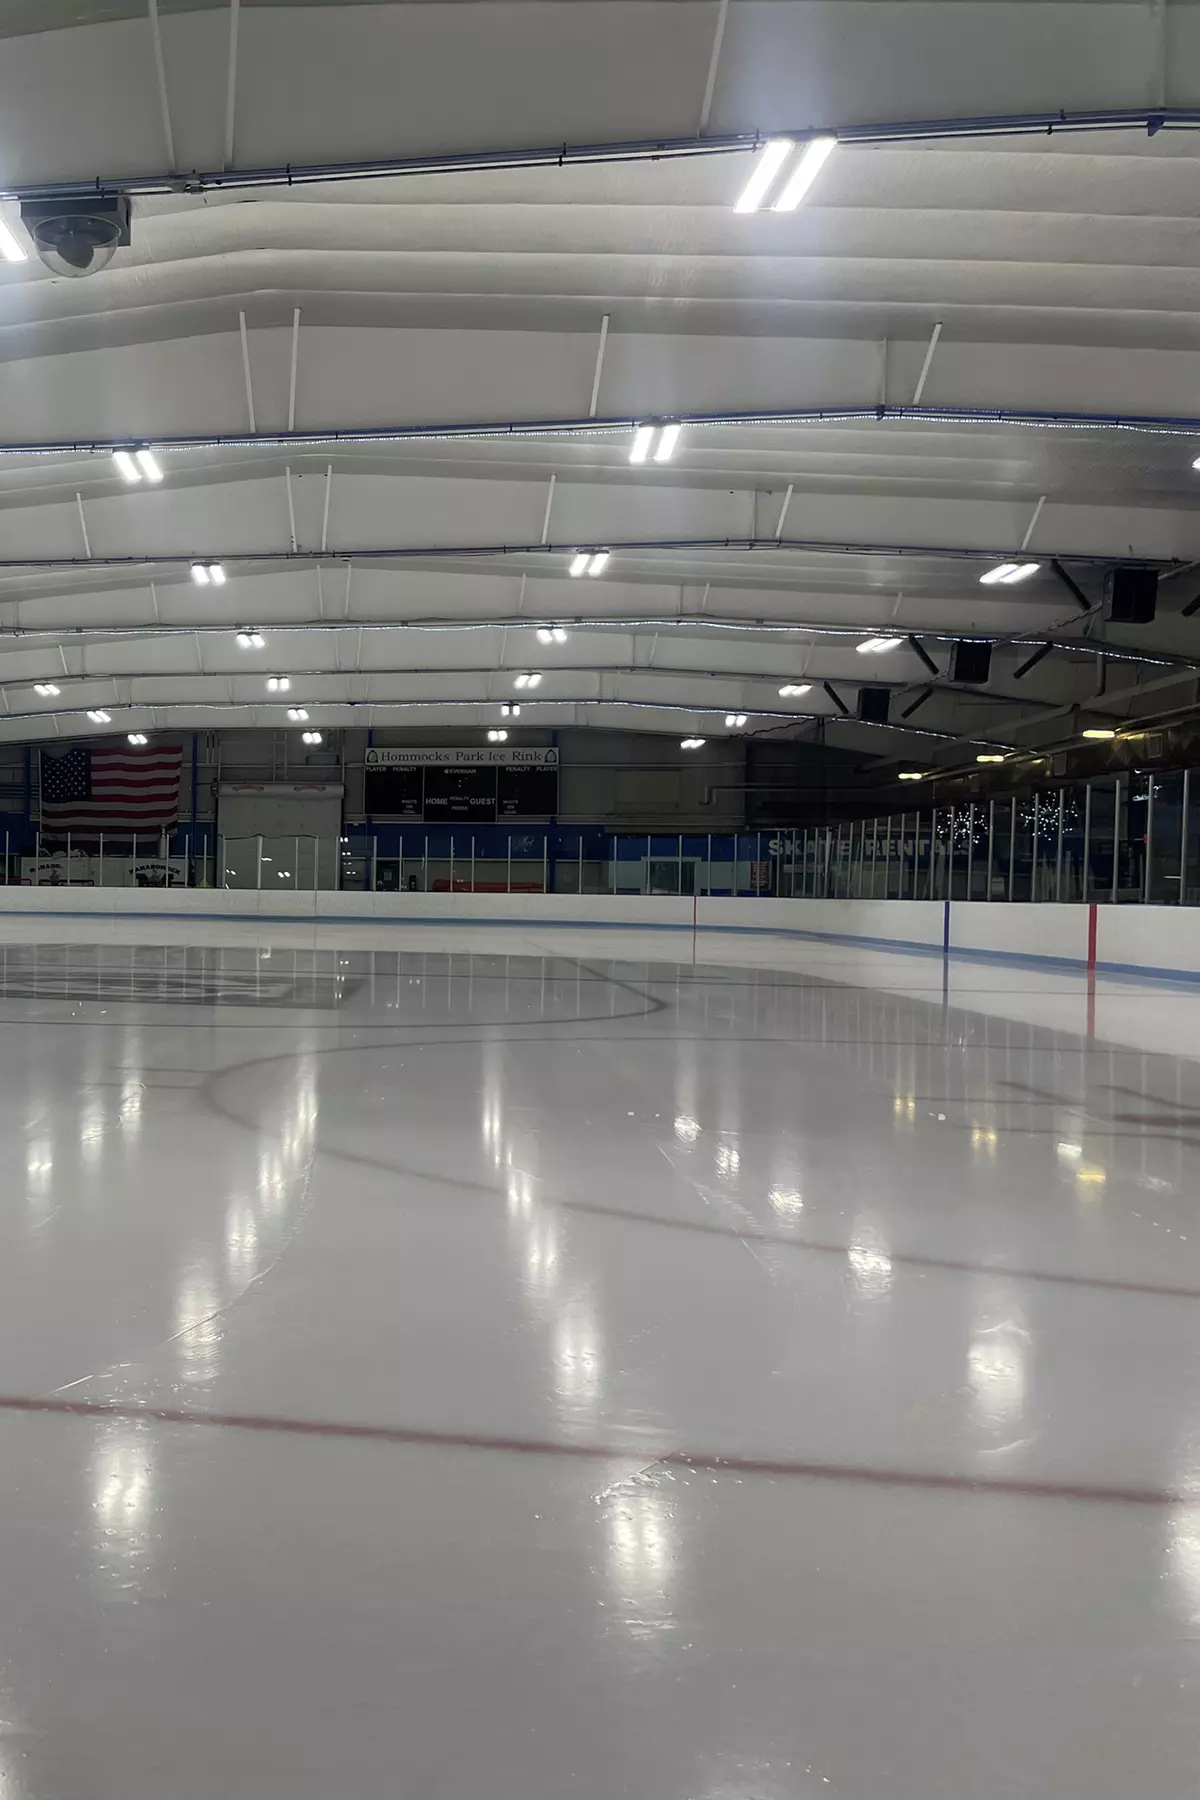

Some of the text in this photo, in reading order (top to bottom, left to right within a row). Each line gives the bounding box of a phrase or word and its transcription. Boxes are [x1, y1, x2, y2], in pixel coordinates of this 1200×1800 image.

[381, 751, 542, 762] Hommocks Park Ice Rink
